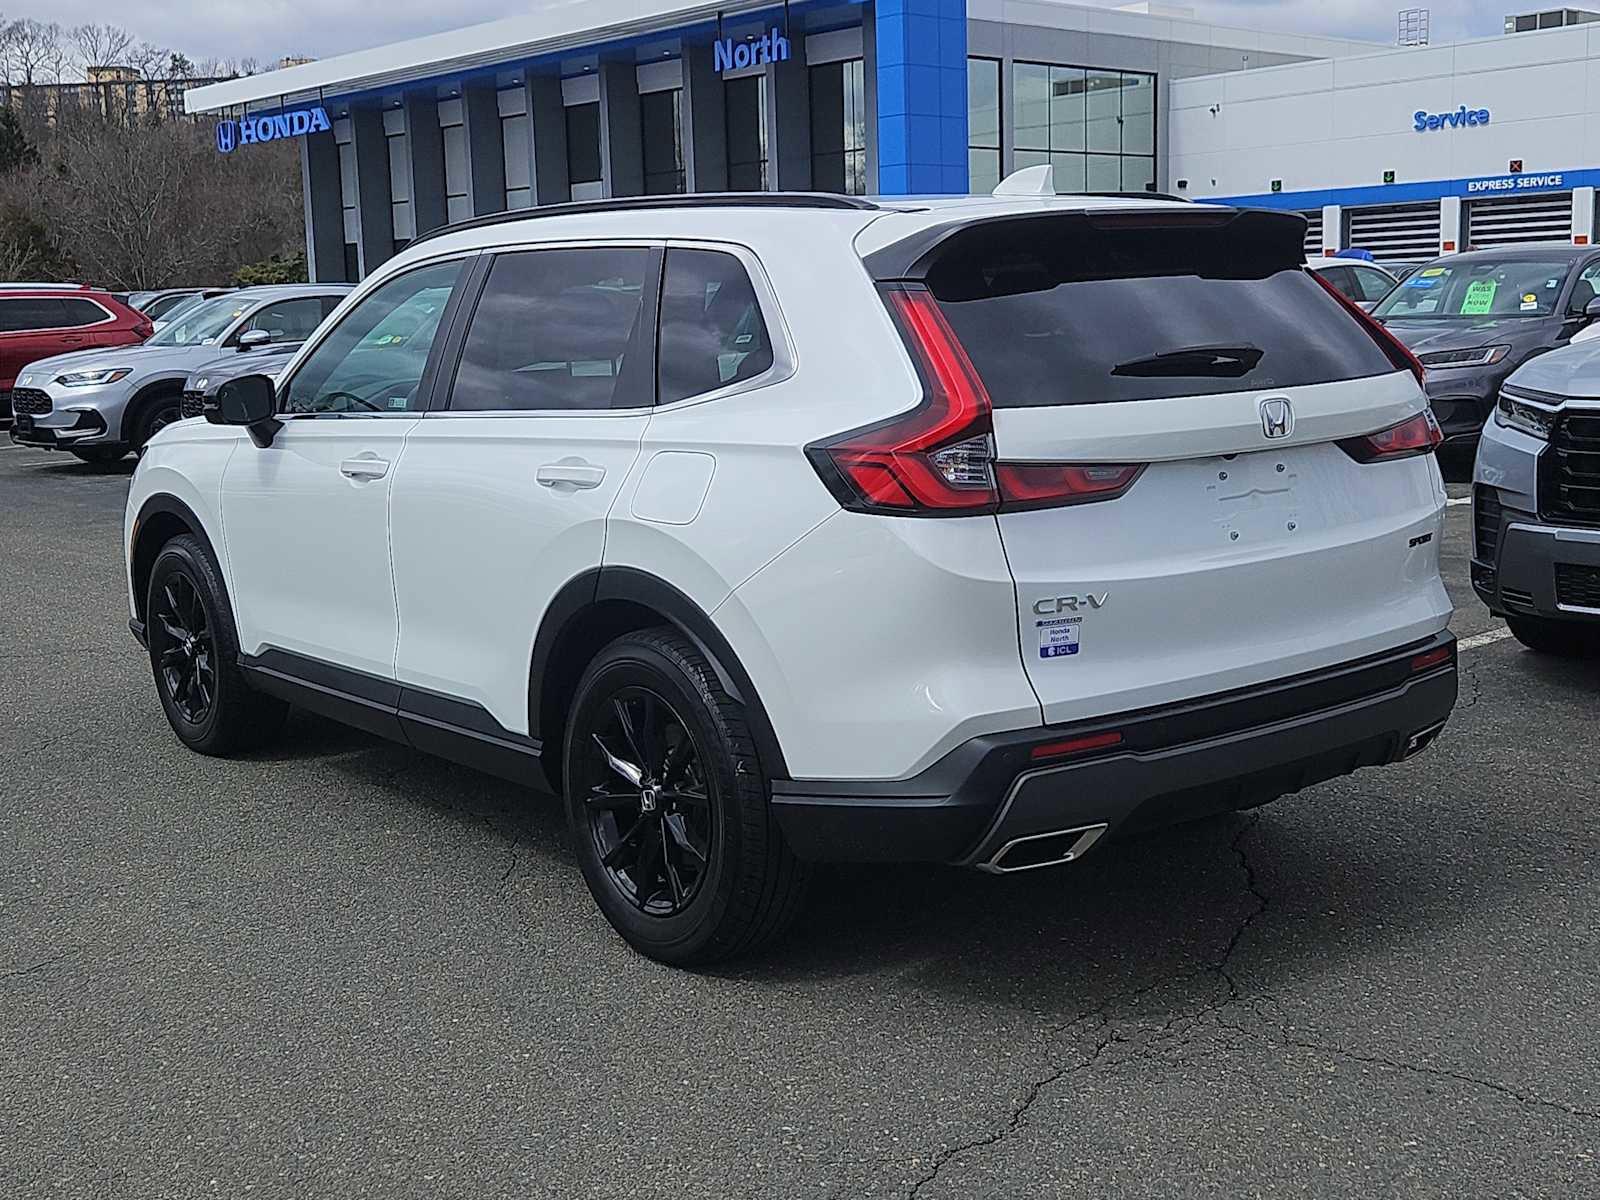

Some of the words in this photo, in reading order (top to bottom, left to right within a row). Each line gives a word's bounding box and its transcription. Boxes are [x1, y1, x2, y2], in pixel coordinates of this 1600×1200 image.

[713, 27, 790, 72] North
[239, 107, 332, 145] HONDA
[1413, 105, 1490, 131] Service
[1467, 179, 1515, 192] EXPRESS
[1516, 175, 1563, 188] SERVICE
[1409, 532, 1433, 548] SPORT
[1033, 591, 1109, 615] CR-V
[1049, 628, 1070, 636] Honda
[1050, 635, 1070, 643] North
